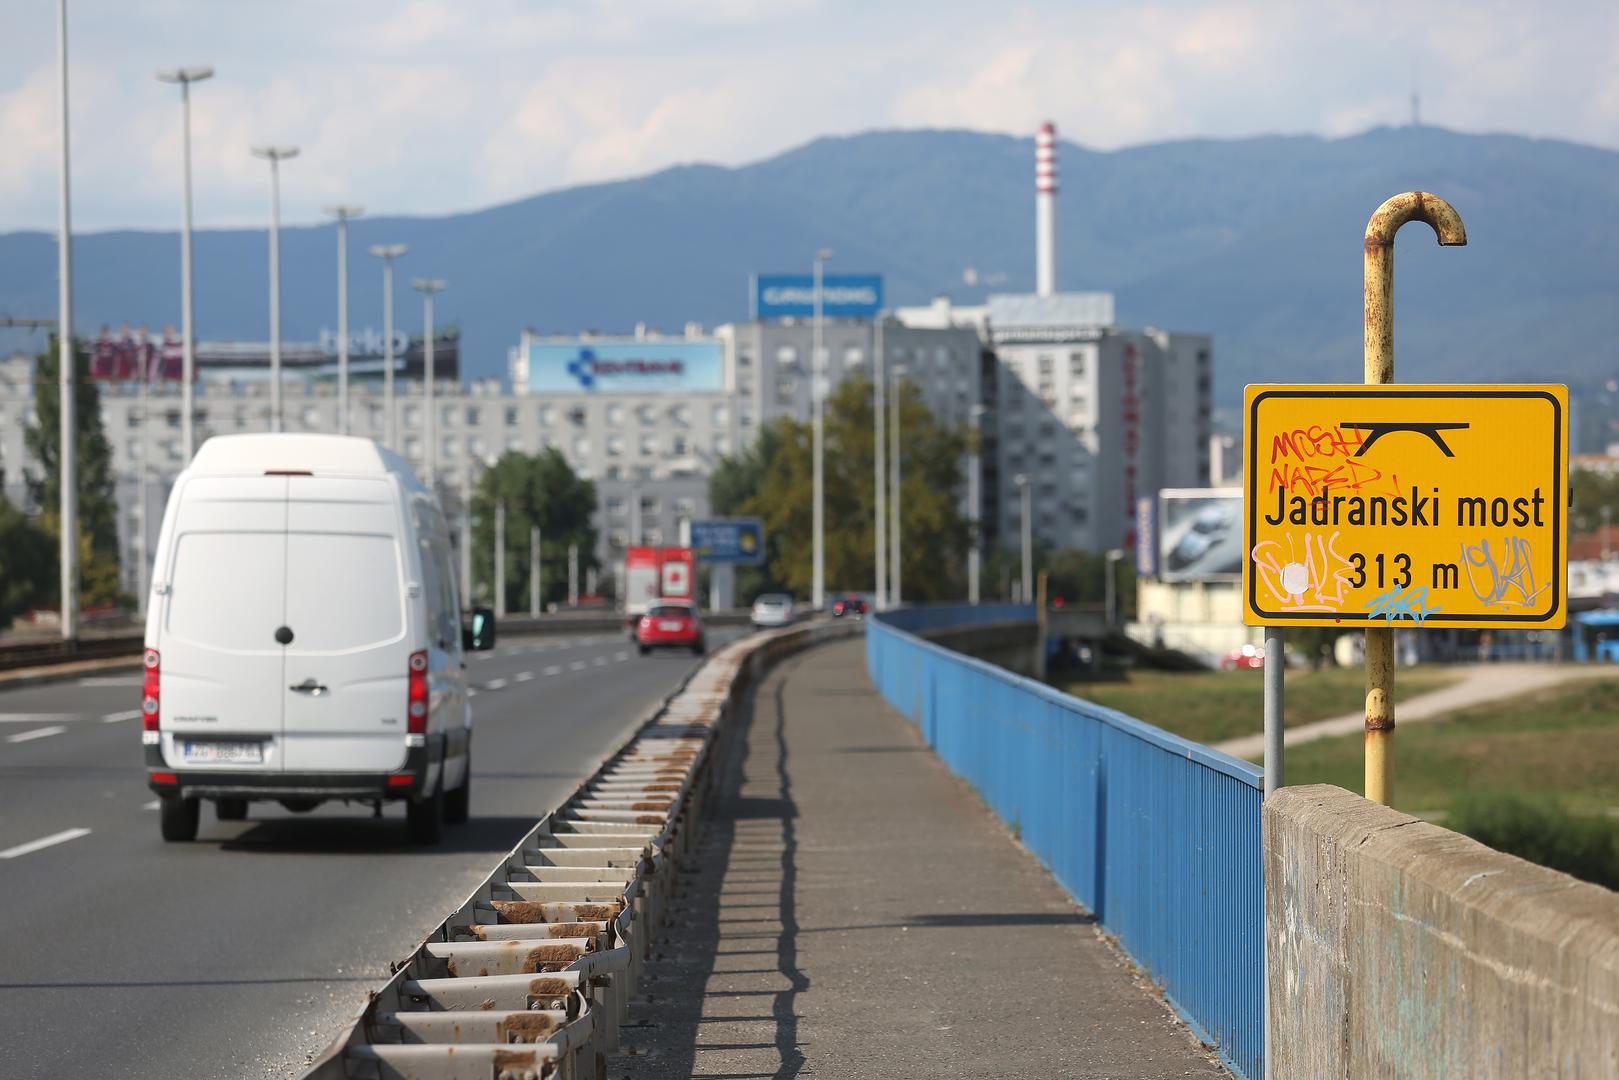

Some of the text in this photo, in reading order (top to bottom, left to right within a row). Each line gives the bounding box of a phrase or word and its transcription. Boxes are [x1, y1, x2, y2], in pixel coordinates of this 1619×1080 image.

[1264, 485, 1545, 527] Jadranski most
[1348, 552, 1413, 589] 313
[1432, 561, 1459, 589] m
